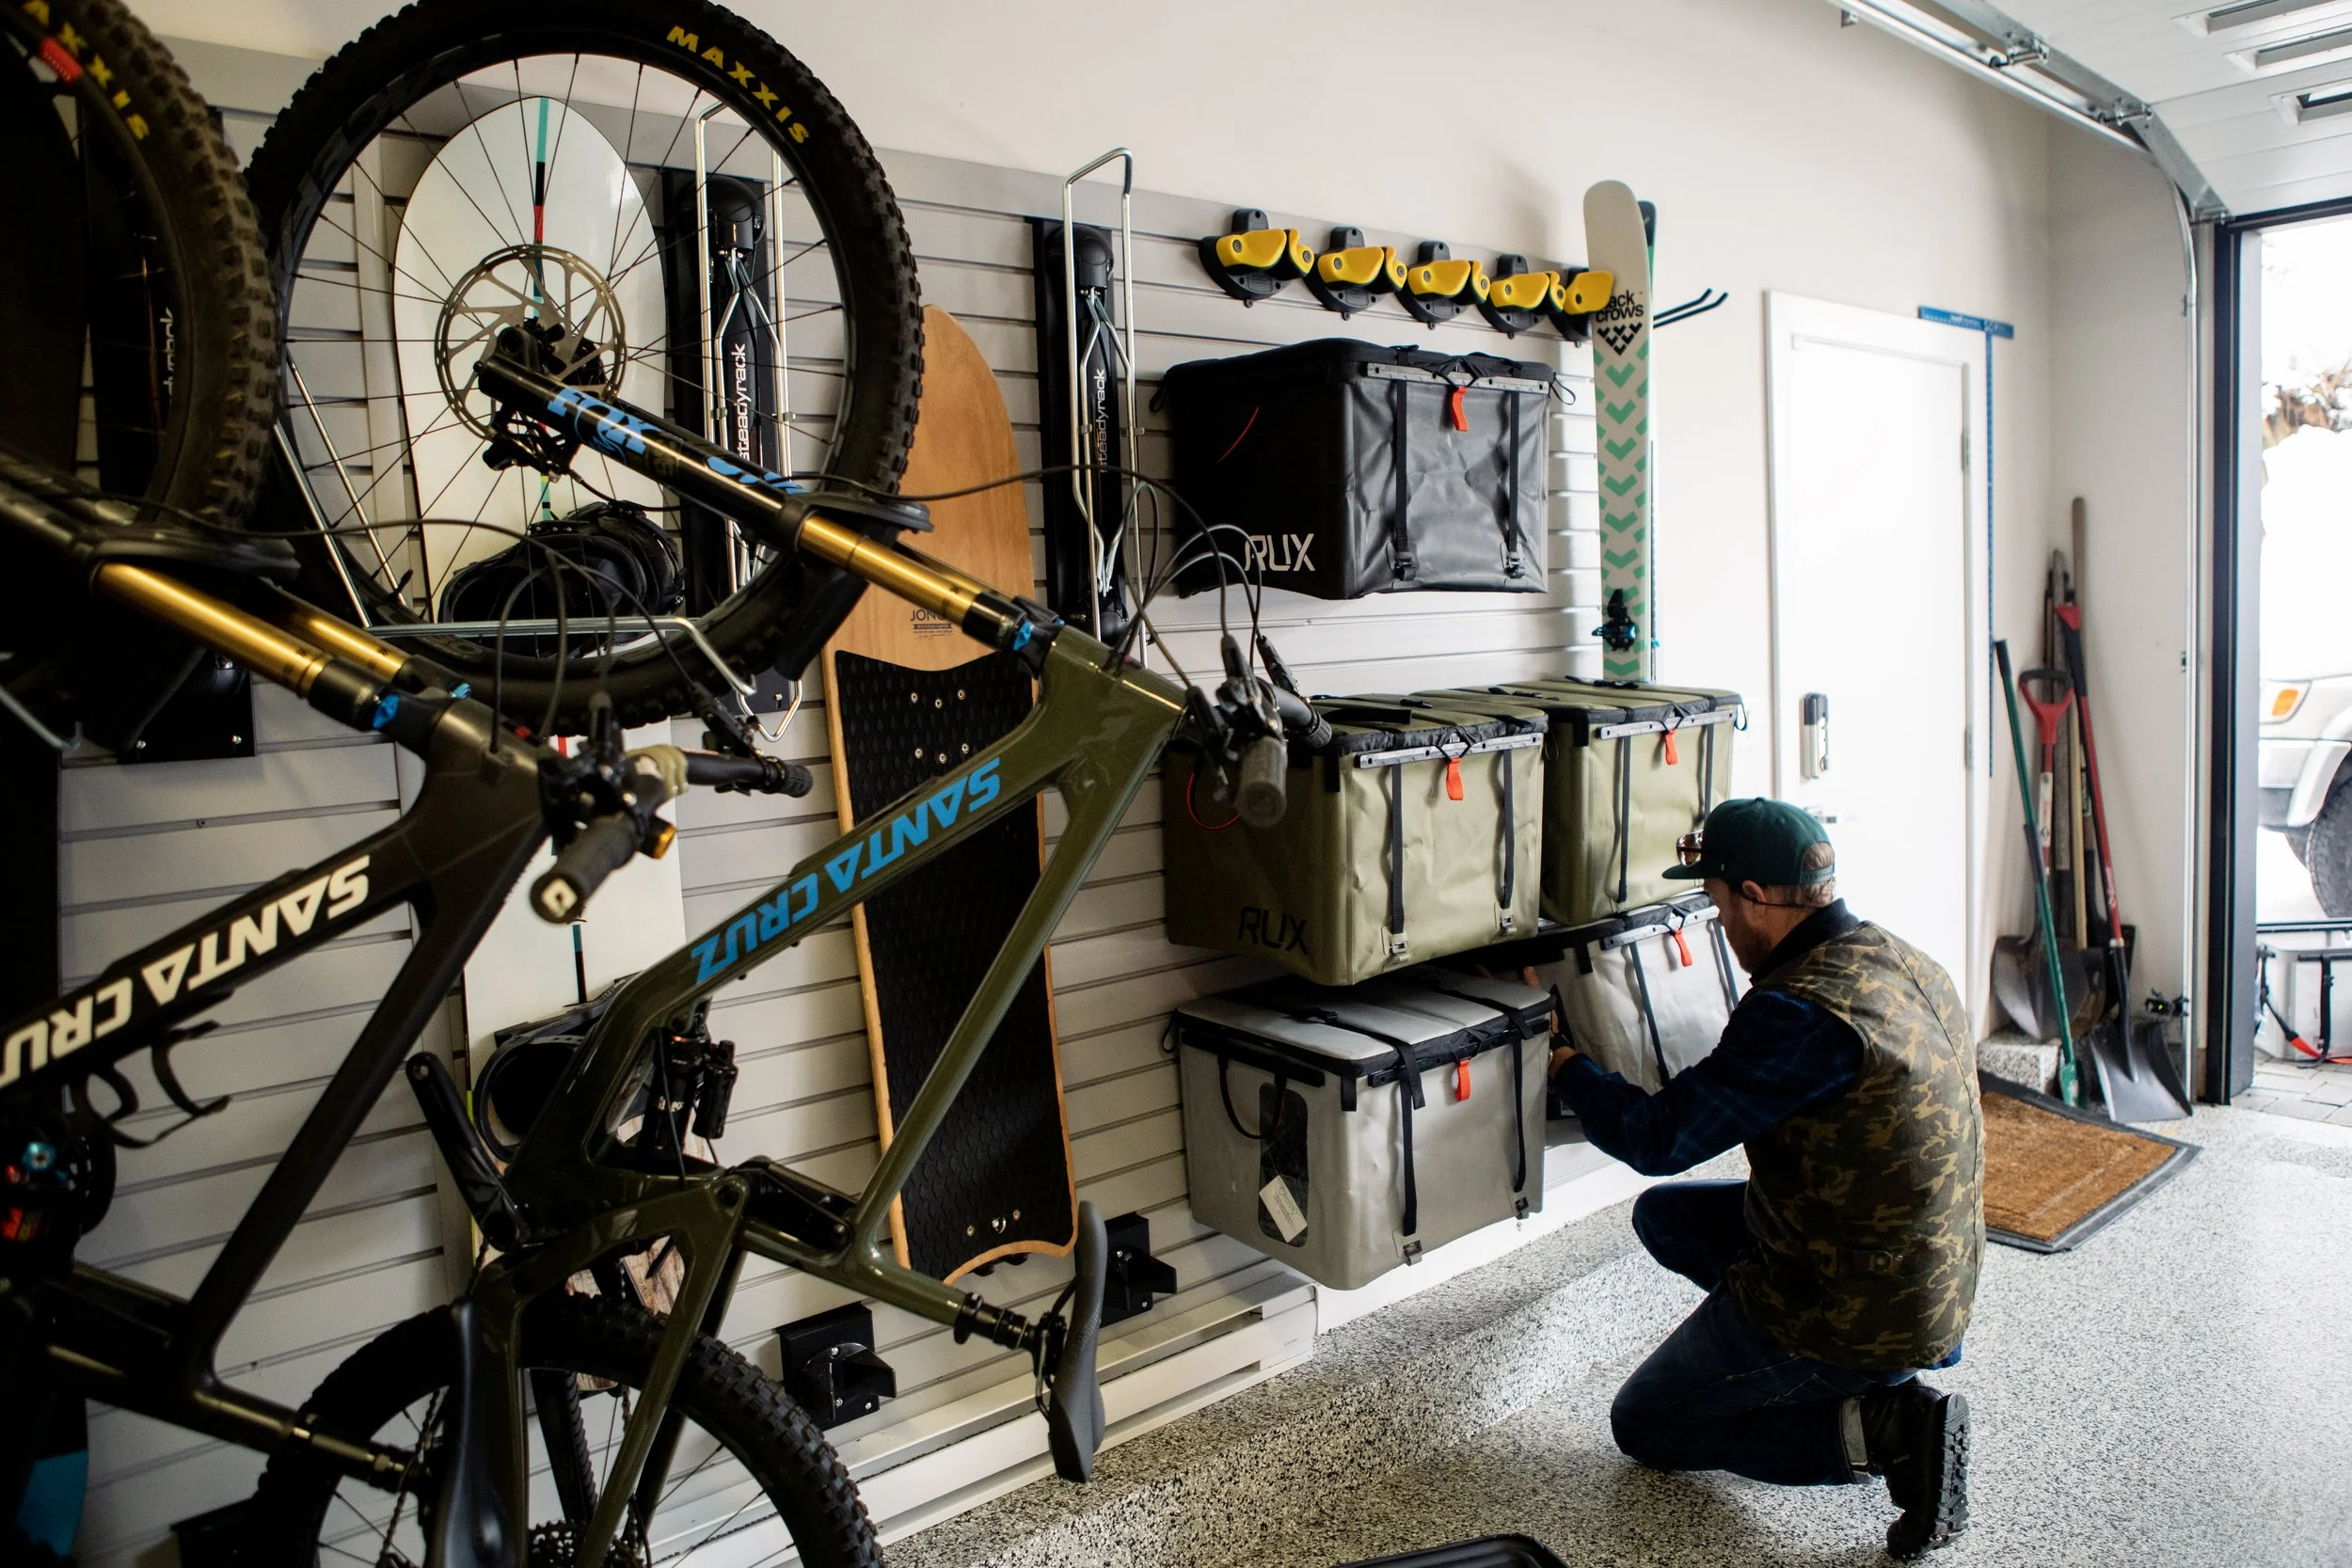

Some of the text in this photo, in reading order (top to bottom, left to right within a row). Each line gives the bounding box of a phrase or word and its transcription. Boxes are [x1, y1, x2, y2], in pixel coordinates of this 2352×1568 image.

[666, 25, 810, 144] MAXXIS
[1596, 304, 1645, 323] crows
[1609, 290, 1635, 309] ack
[731, 342, 751, 462] steadyrack
[1244, 532, 1316, 572] RUX
[910, 609, 948, 622] JON
[691, 756, 1000, 984] SANTA CRUZ
[140, 854, 371, 1006] SANTA
[1236, 905, 1310, 957] RUX
